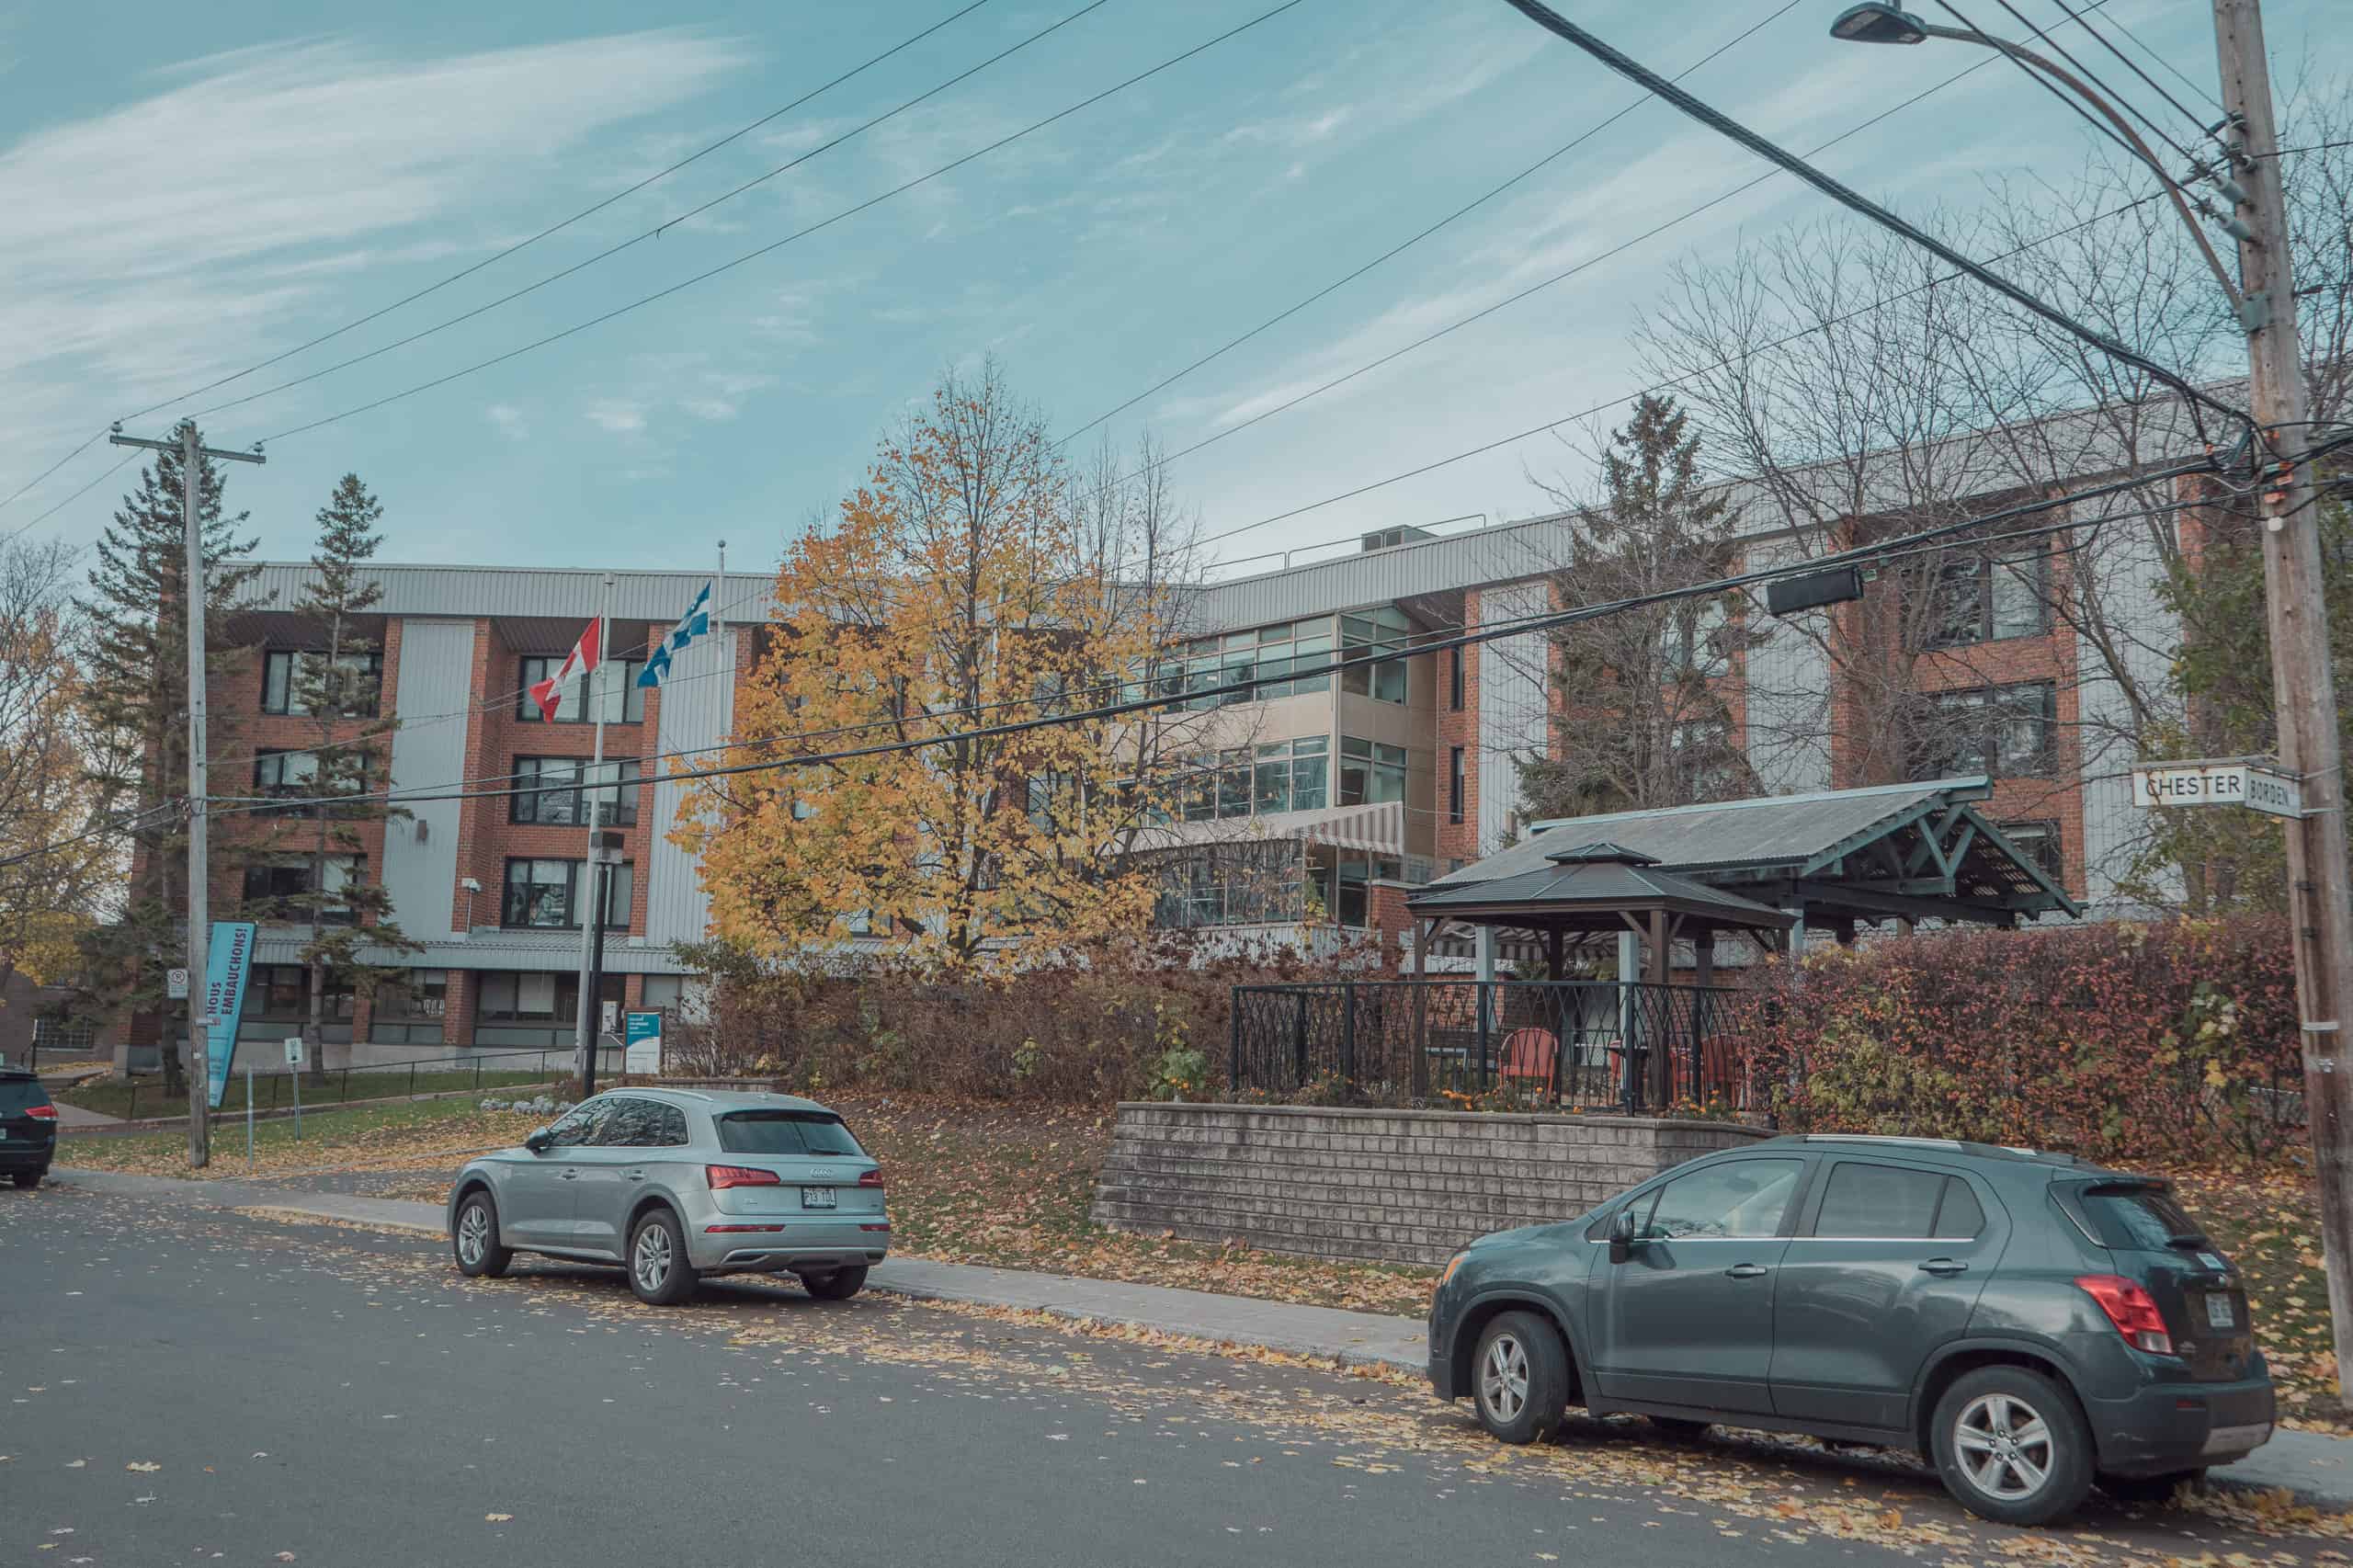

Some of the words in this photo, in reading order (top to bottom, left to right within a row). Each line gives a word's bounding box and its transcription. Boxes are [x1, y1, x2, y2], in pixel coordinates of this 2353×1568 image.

[2145, 775, 2242, 797] CHESTER
[2249, 779, 2290, 807] BORDEN
[221, 928, 247, 1015] EMBAUCHONS!
[207, 982, 222, 1014] NOUS
